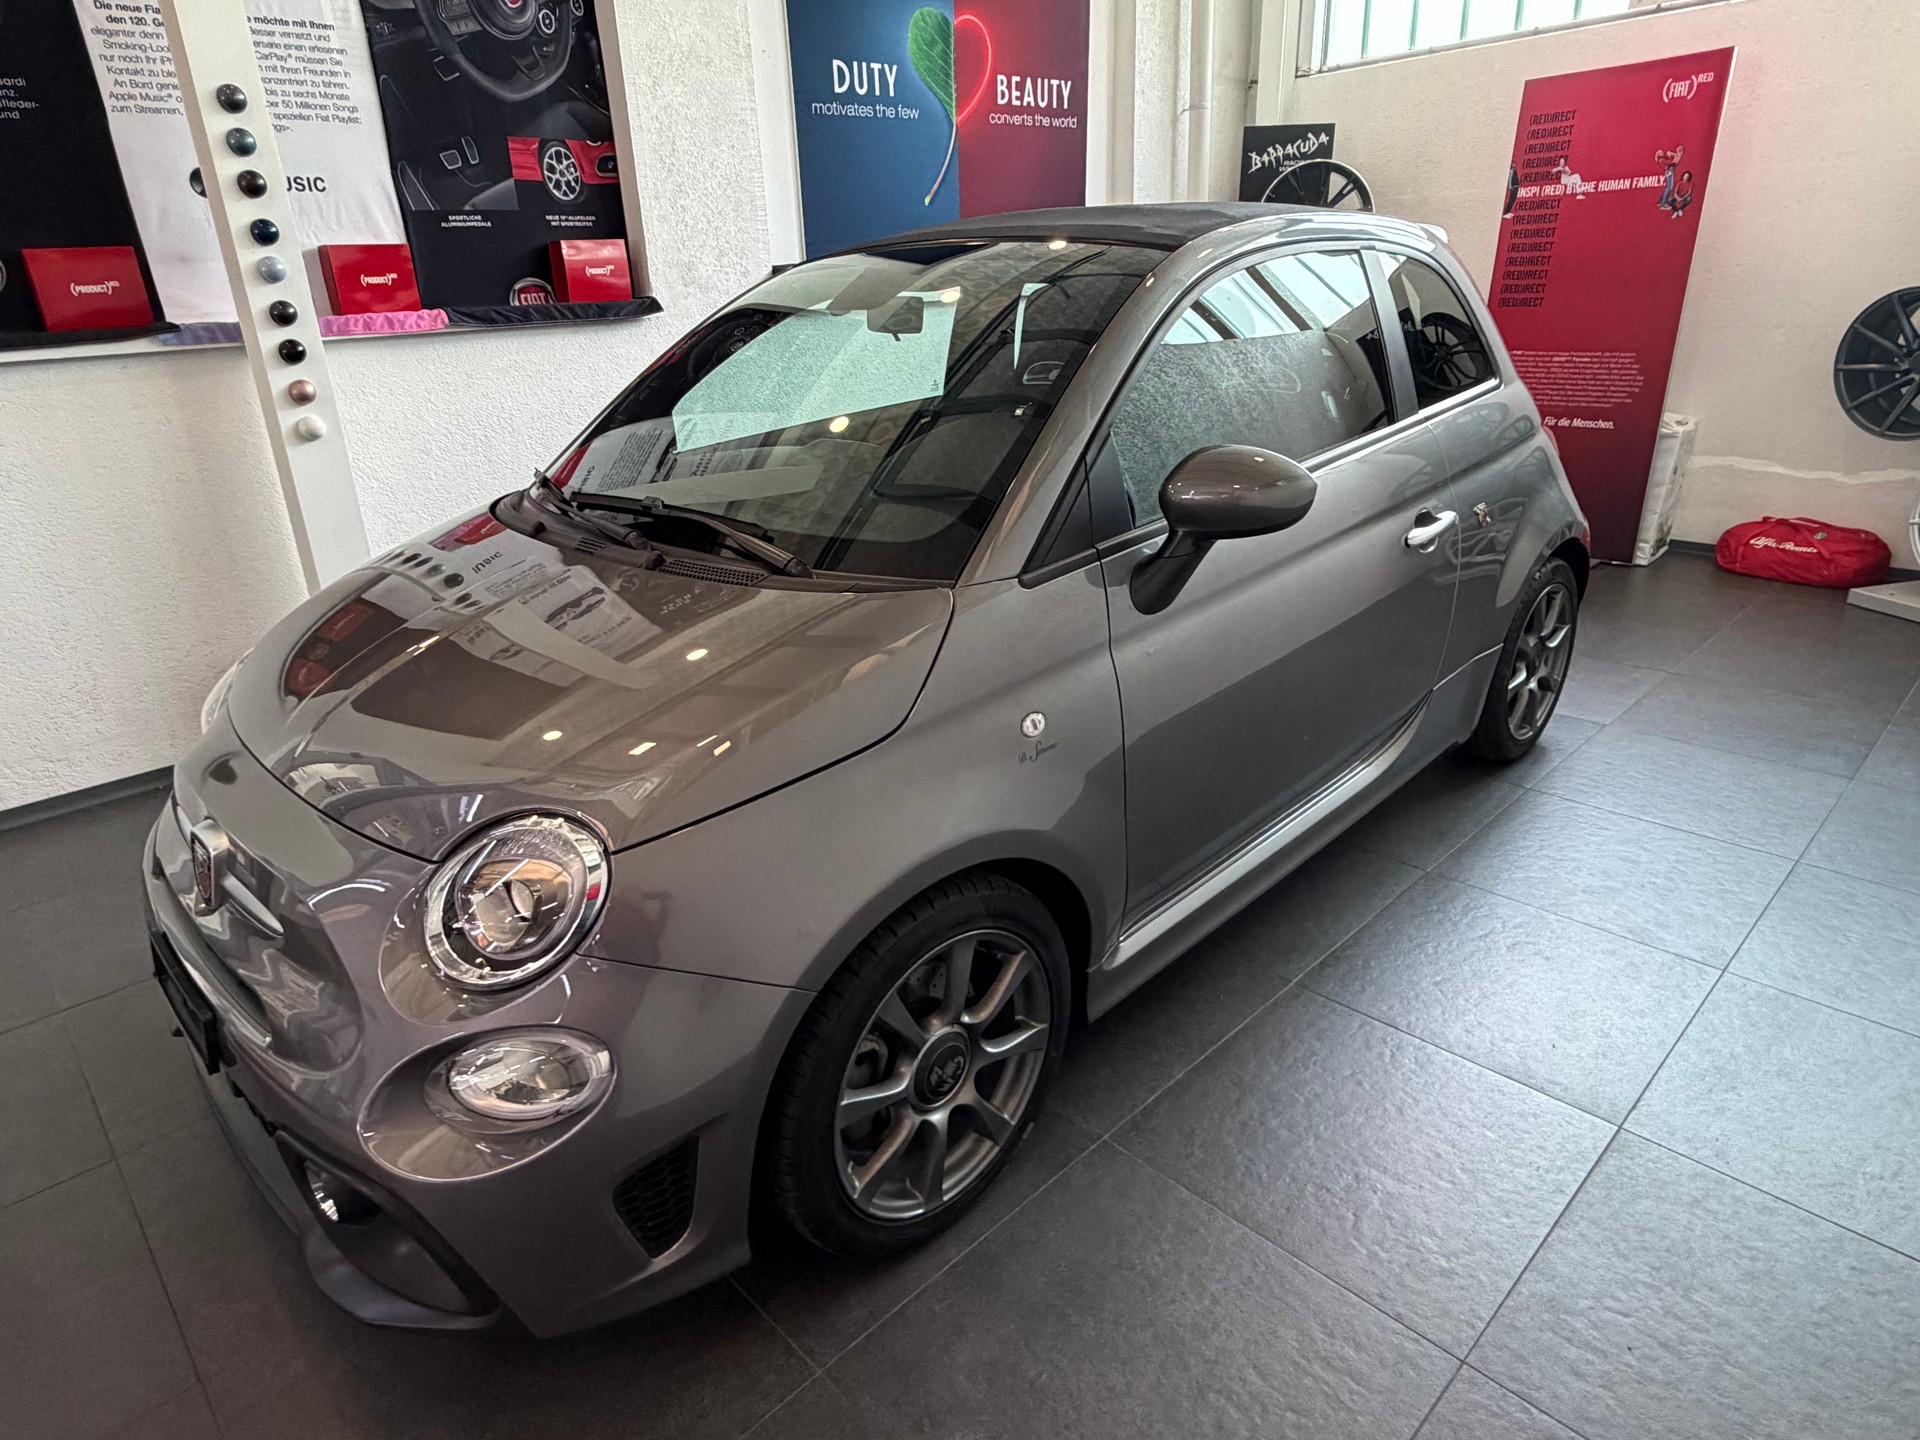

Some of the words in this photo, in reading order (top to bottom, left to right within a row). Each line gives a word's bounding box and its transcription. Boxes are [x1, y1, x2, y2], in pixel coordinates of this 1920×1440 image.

[106, 14, 127, 25] den
[128, 16, 150, 27] 120.
[278, 30, 313, 41] vernetzt
[314, 34, 331, 43] und
[116, 4, 142, 14] neue
[253, 16, 290, 27] möchte
[292, 20, 308, 28] mit
[308, 20, 335, 31] Ihnen
[90, 26, 136, 38] eleganter
[140, 30, 164, 40] denn
[283, 42, 308, 52] einen
[308, 44, 348, 56] erlesenen
[98, 54, 116, 62] nur
[118, 54, 144, 64] noch
[144, 54, 158, 65] Ihr
[264, 63, 280, 74] mit
[280, 64, 302, 74] Ihren
[302, 66, 342, 78] Freunden
[343, 70, 352, 79] in
[294, 54, 329, 66] müssen
[330, 56, 344, 67] Sie
[106, 65, 146, 76] Kontakt
[148, 70, 160, 78] zu
[310, 80, 321, 88] zu
[321, 80, 350, 90] fahren.
[113, 78, 128, 88] An
[129, 79, 154, 90] Bord
[264, 86, 280, 97] bis
[280, 89, 291, 97] zu
[292, 88, 318, 99] sechs
[318, 90, 350, 101] Monate
[832, 59, 898, 97] DUTY
[108, 90, 138, 102] Apple
[282, 100, 294, 110] 50
[294, 101, 331, 112] Millionen
[332, 102, 359, 114] Songs
[996, 74, 1072, 110] BEAUTY
[110, 104, 132, 114] zum
[273, 112, 314, 123] speziellen
[314, 113, 330, 123] Fiat
[812, 101, 874, 118] motivates
[876, 102, 896, 118] the
[898, 104, 920, 119] few
[989, 112, 1033, 126] converts
[1034, 113, 1050, 126] the
[1052, 114, 1077, 128] world
[1516, 186, 1540, 198] INSPI
[1541, 184, 1565, 197] (RED)
[1598, 178, 1632, 192] HUMAN
[1632, 174, 1667, 188] FAMILY.
[1520, 170, 1562, 184] (RED)IREC
[1543, 416, 1558, 426] Für
[1558, 418, 1570, 427] die
[1571, 418, 1615, 430] Menschen.
